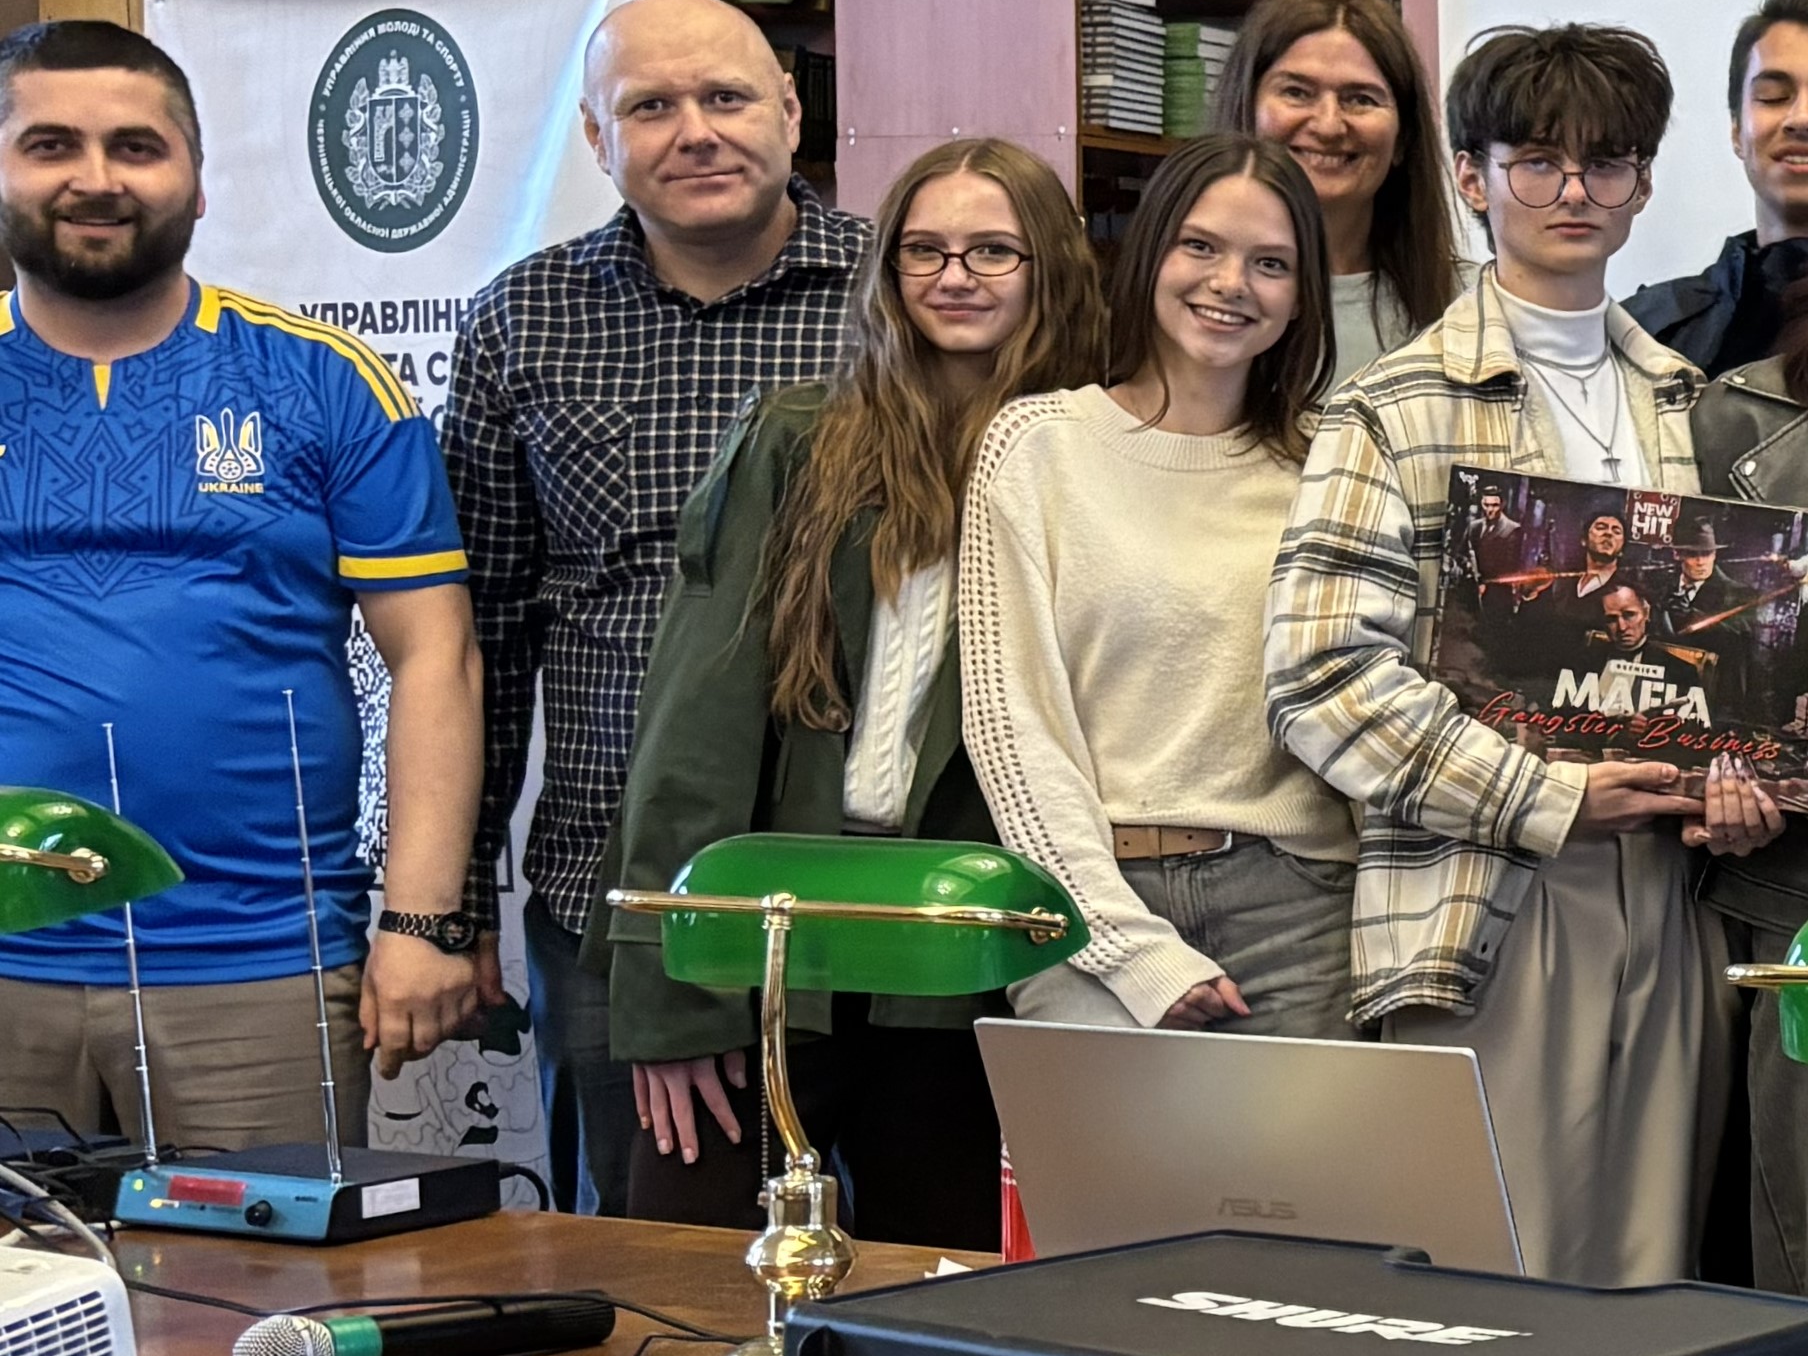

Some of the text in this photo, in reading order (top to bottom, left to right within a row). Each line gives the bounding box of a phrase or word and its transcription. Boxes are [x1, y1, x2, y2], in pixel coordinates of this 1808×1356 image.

[377, 20, 420, 35] МОЛОДІ
[421, 27, 435, 44] ТА
[435, 40, 465, 88] СПОРТУ
[198, 481, 264, 494] UKRAINE
[1632, 515, 1672, 537] HIT
[1633, 501, 1674, 522] NEW
[1552, 668, 1711, 728] MAFIA
[1478, 692, 1782, 761] Gangster Business
[1218, 1197, 1297, 1220] ASUS
[1136, 1291, 1520, 1346] SHURE
